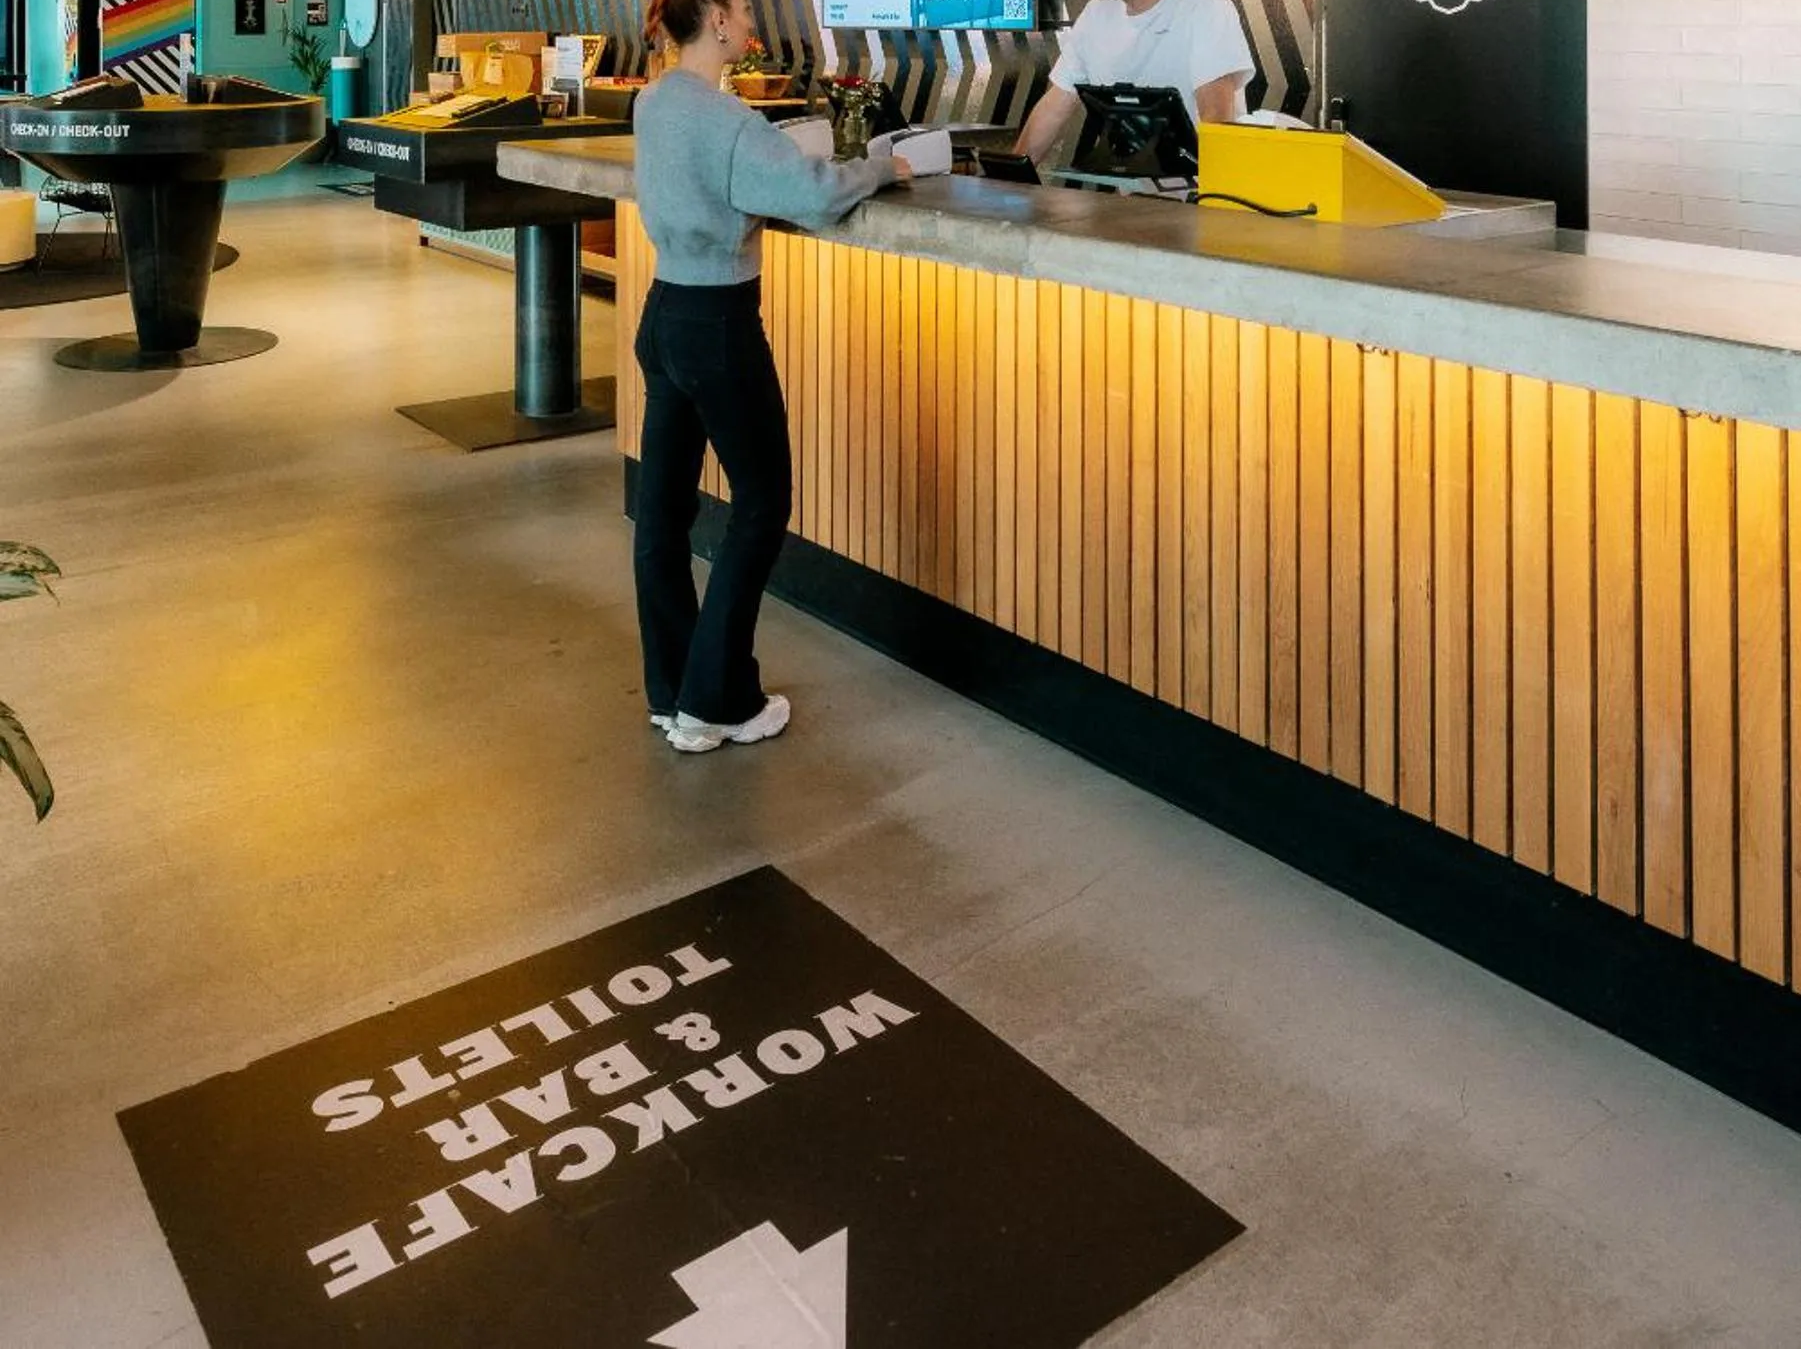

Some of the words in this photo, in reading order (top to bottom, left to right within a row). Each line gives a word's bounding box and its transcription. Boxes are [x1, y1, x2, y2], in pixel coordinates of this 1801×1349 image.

[59, 124, 131, 138] CHECK-OUT
[310, 942, 734, 1133] TOILETS
[654, 1011, 721, 1052] &
[306, 989, 921, 1300] WORKCAFE
[414, 1039, 658, 1162] BAR
